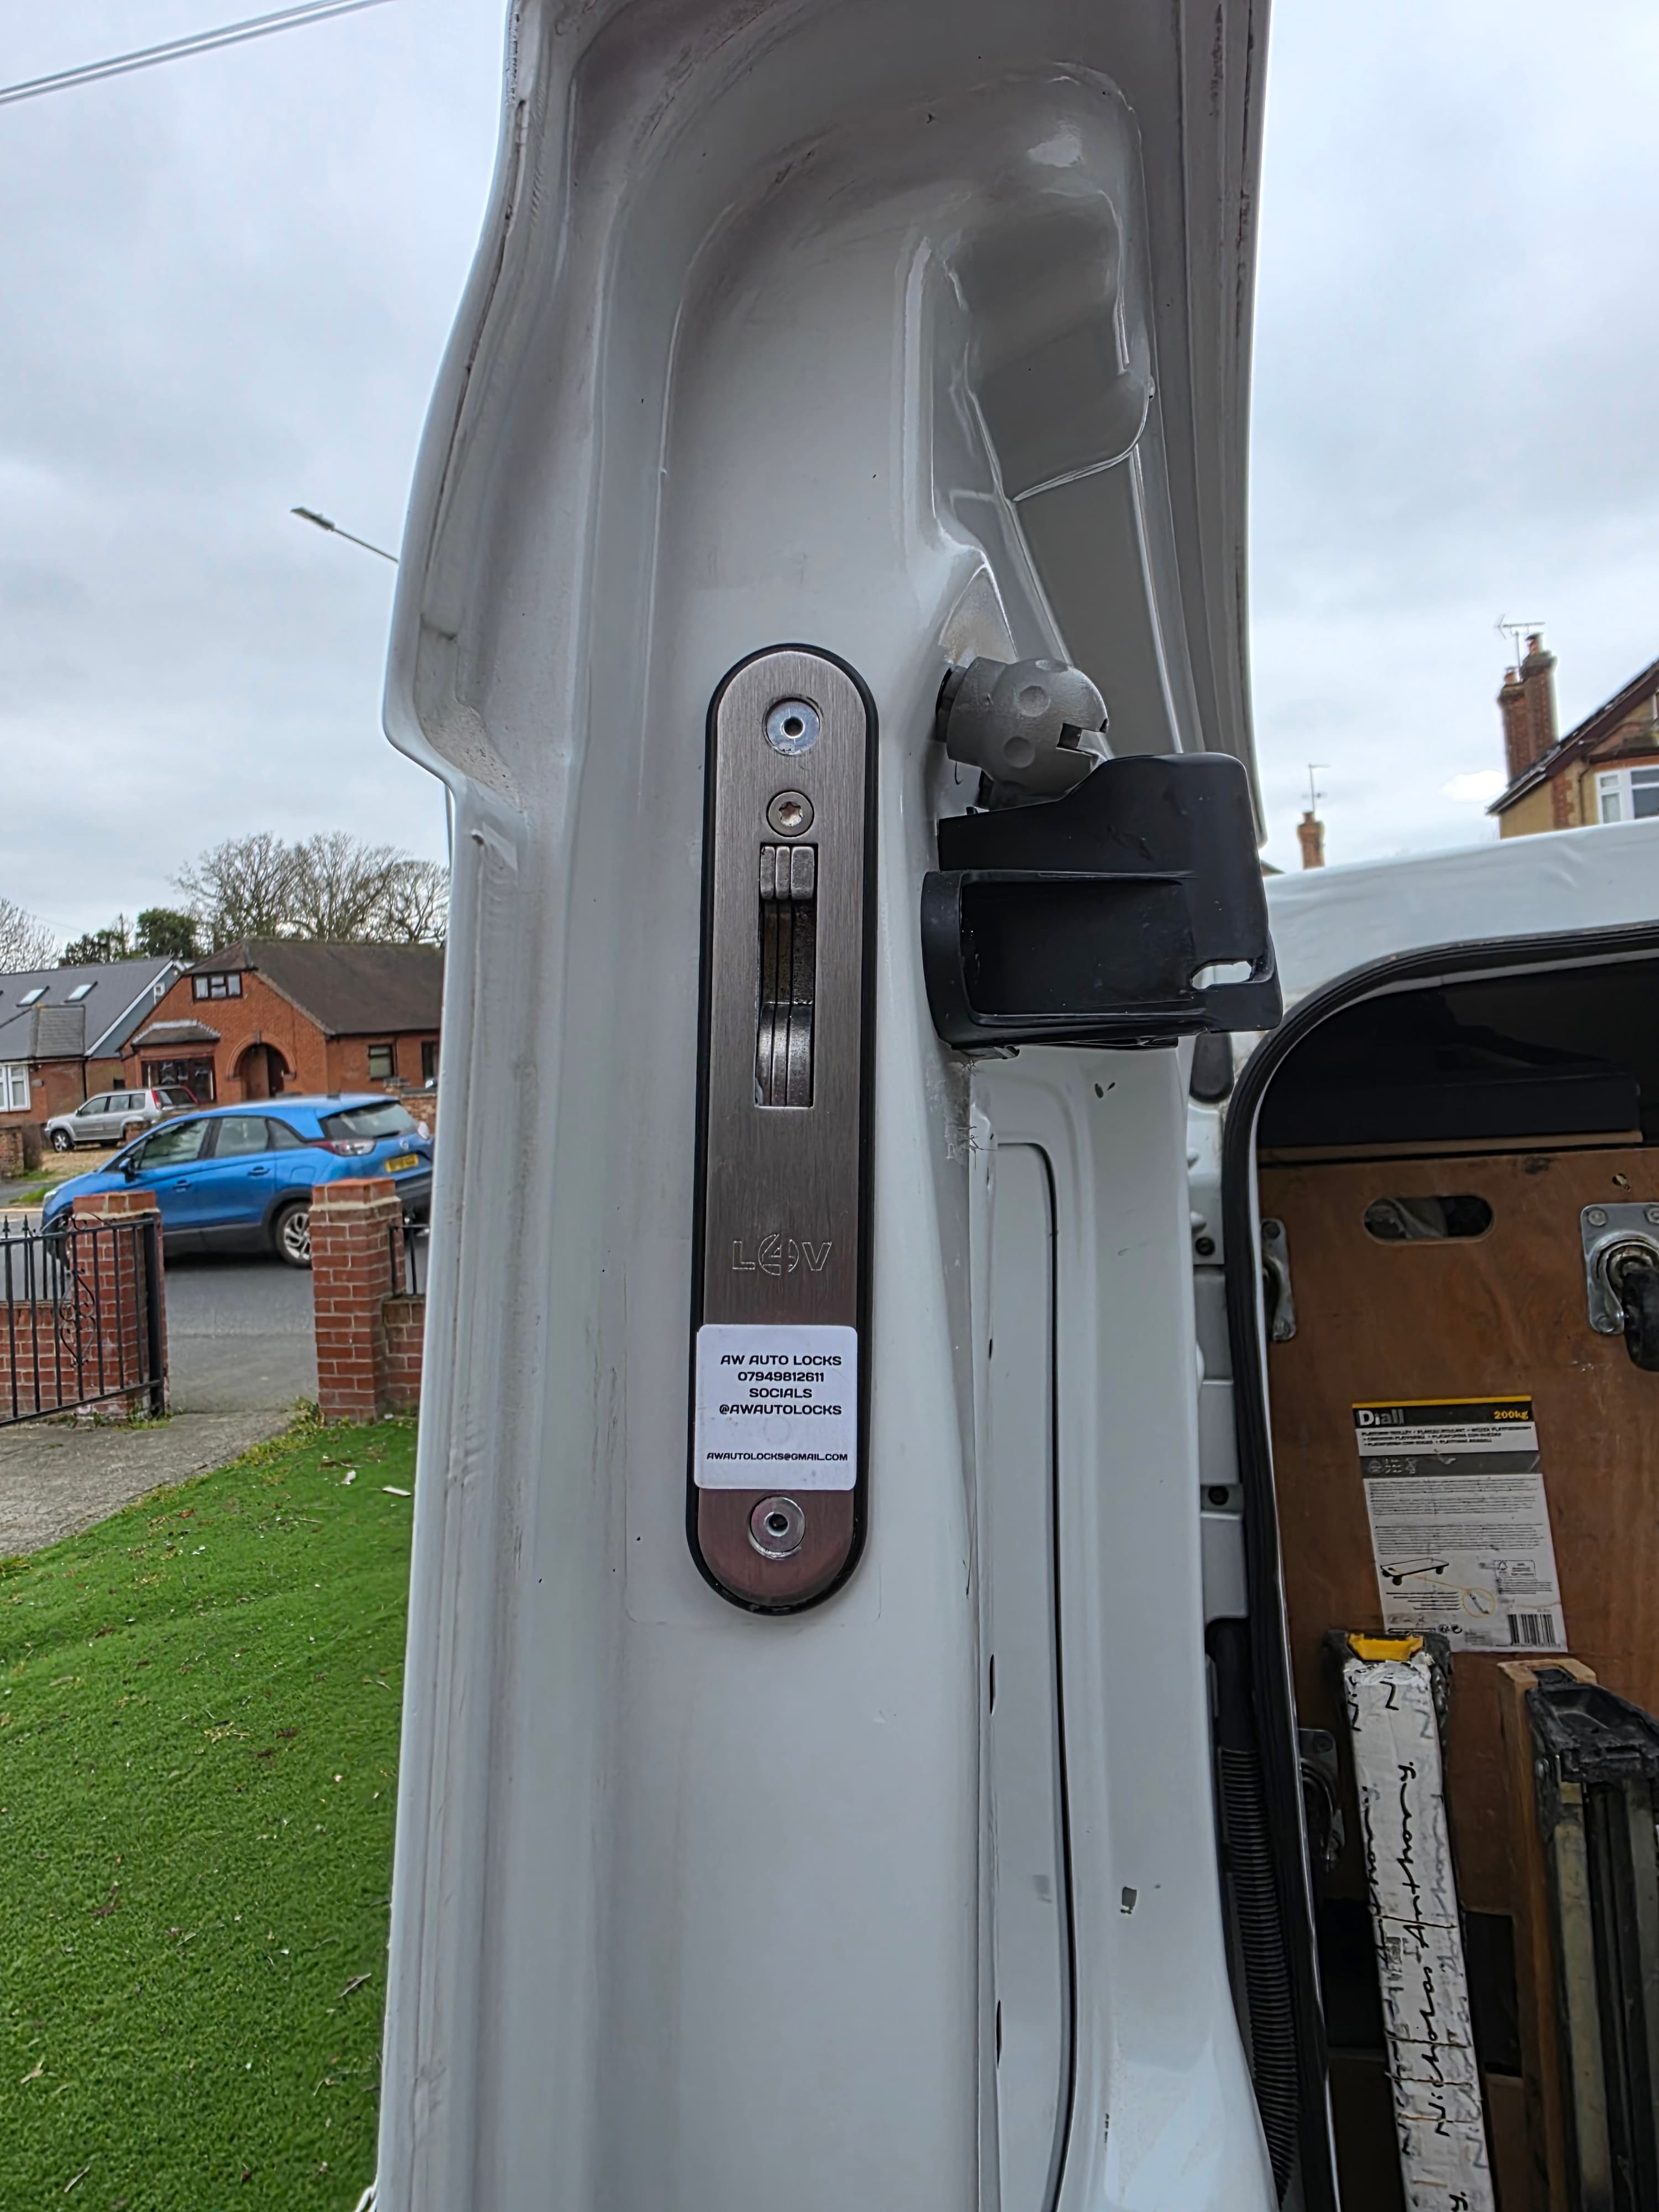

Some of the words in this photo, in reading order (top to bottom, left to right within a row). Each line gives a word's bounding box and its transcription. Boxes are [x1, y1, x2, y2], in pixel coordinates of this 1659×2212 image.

[721, 1355, 745, 1365] AW
[749, 1355, 789, 1365] AUTO
[794, 1355, 842, 1365] LOCKS
[738, 1371, 824, 1382] 07949812611
[749, 1388, 812, 1398] SOCIALS
[719, 1404, 842, 1415] @AWAUTOLOCKS
[1359, 1408, 1405, 1426] Diall
[1494, 1411, 1529, 1420] 200kg
[707, 1452, 848, 1460] AWAUTOLOCKS@GMAIL.COM
